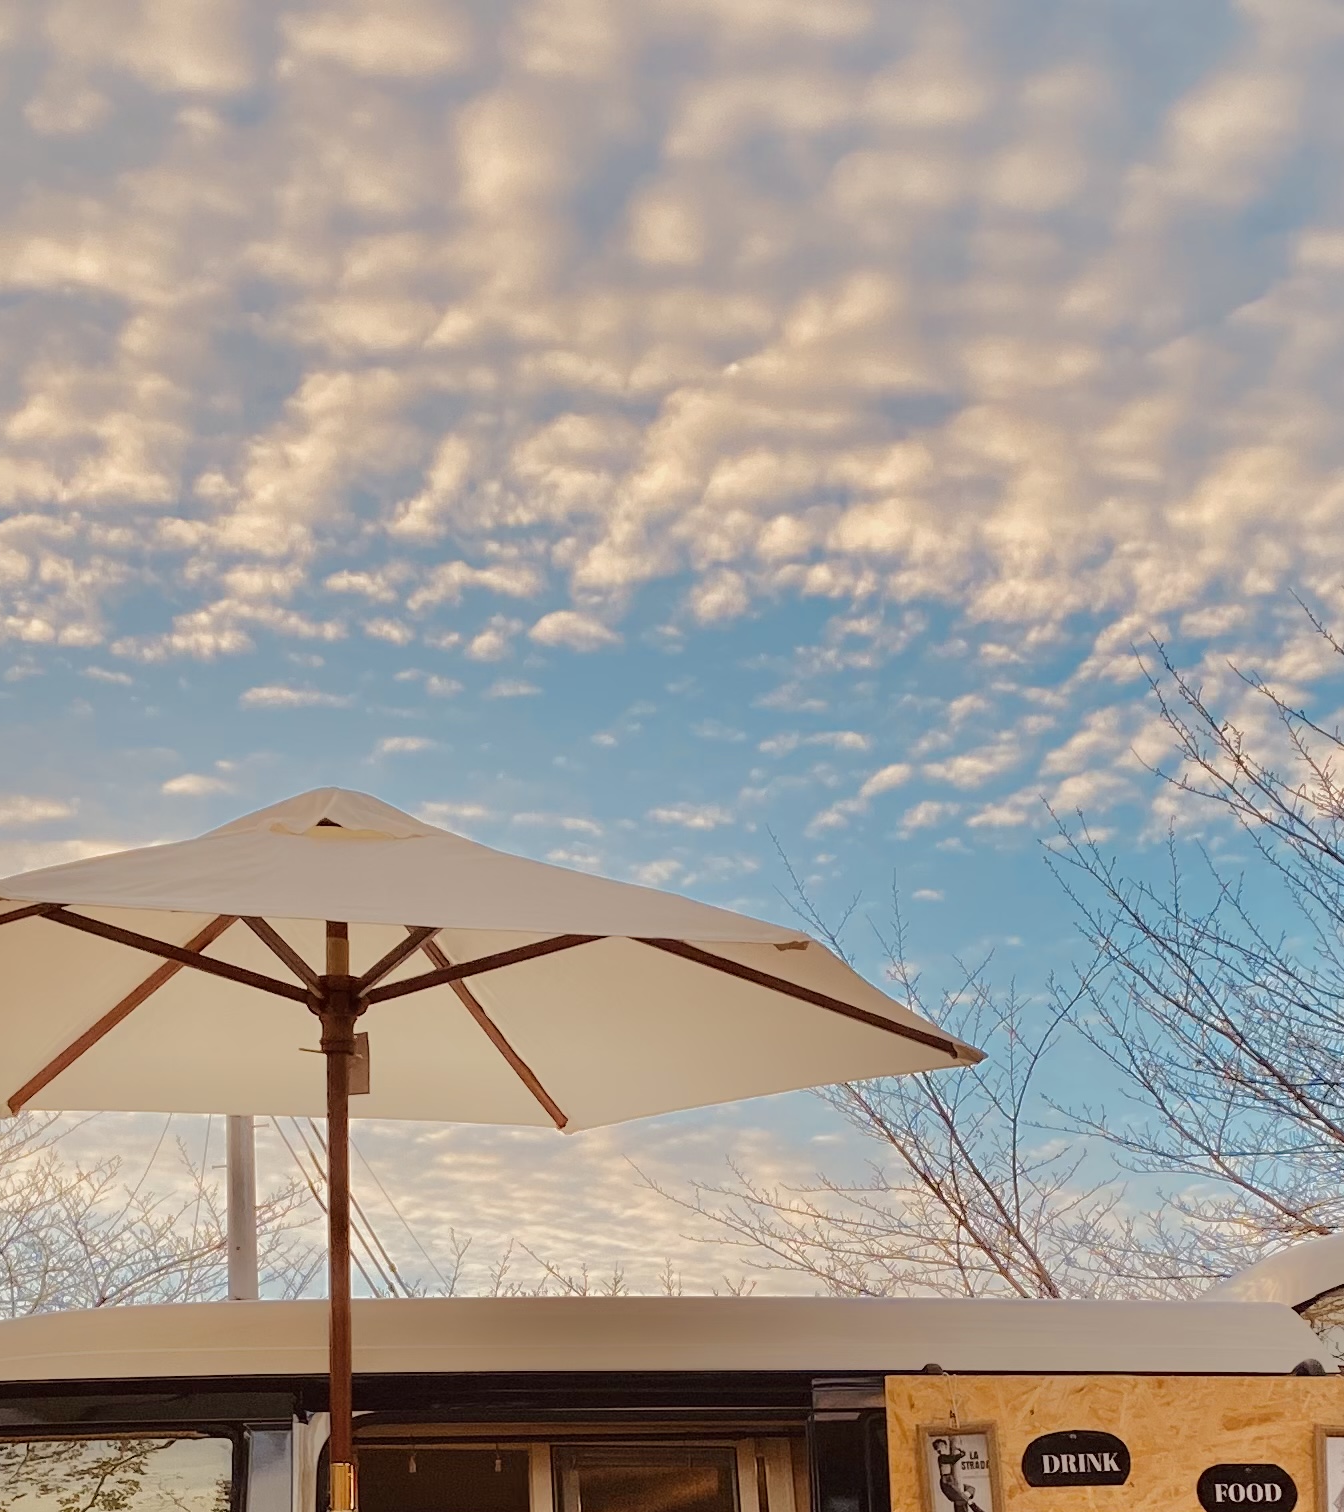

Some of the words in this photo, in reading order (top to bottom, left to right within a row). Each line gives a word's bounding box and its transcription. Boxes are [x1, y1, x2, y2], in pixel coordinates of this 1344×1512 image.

[970, 1451, 978, 1460] LA
[1042, 1452, 1121, 1474] DRINK
[1214, 1483, 1282, 1503] FOOD
